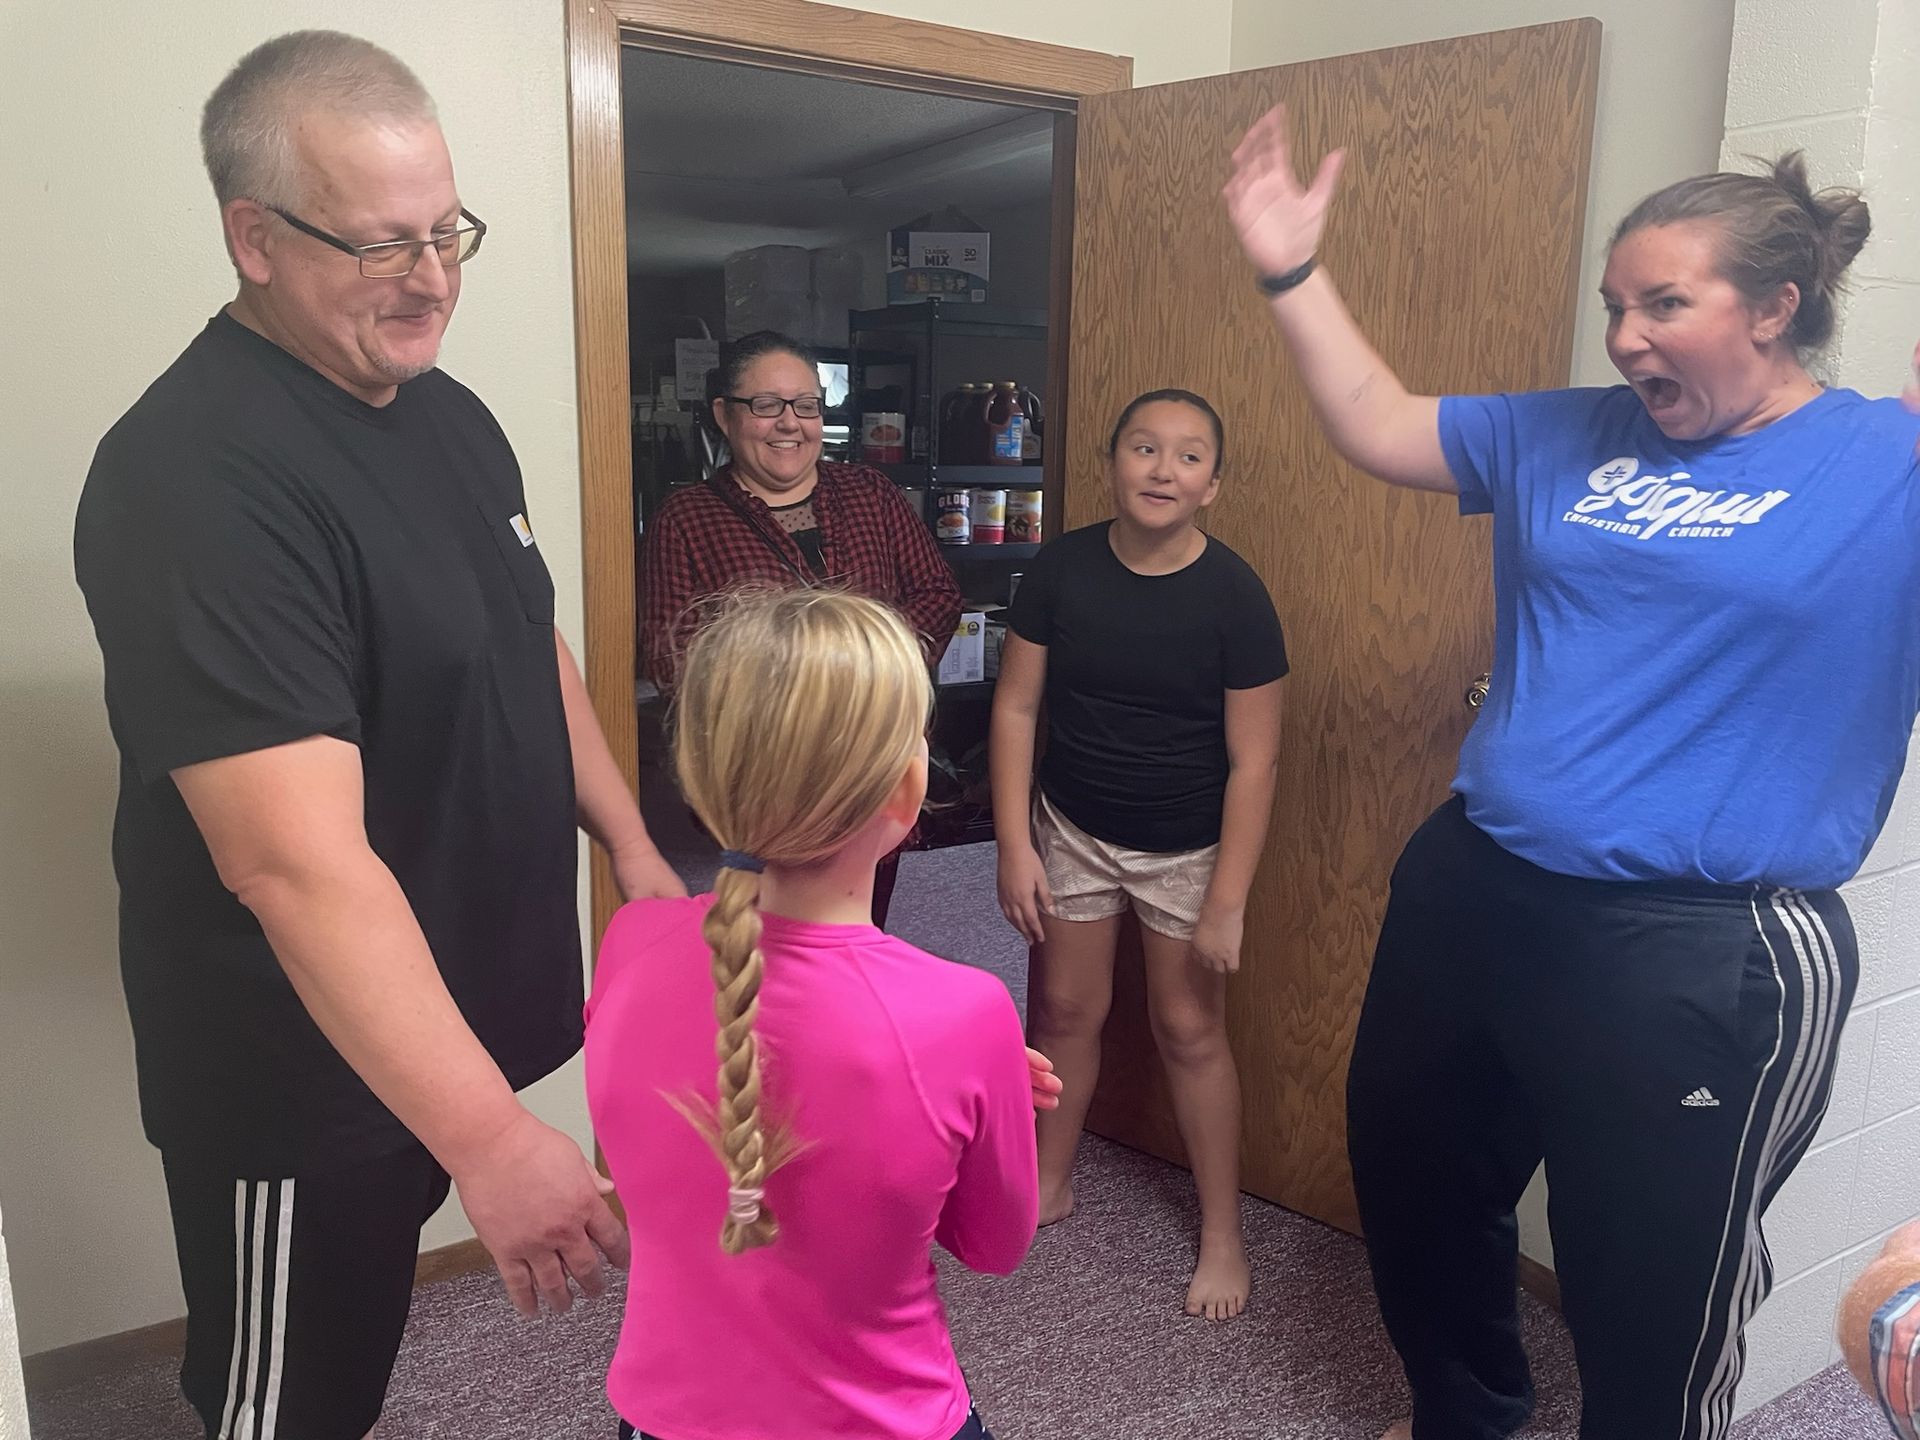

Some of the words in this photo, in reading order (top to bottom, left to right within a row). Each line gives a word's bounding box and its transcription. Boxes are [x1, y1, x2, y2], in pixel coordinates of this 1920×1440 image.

[925, 255, 949, 266] MIX
[1562, 512, 1642, 535] CHRISTIAN
[1668, 527, 1734, 538] CHURCH
